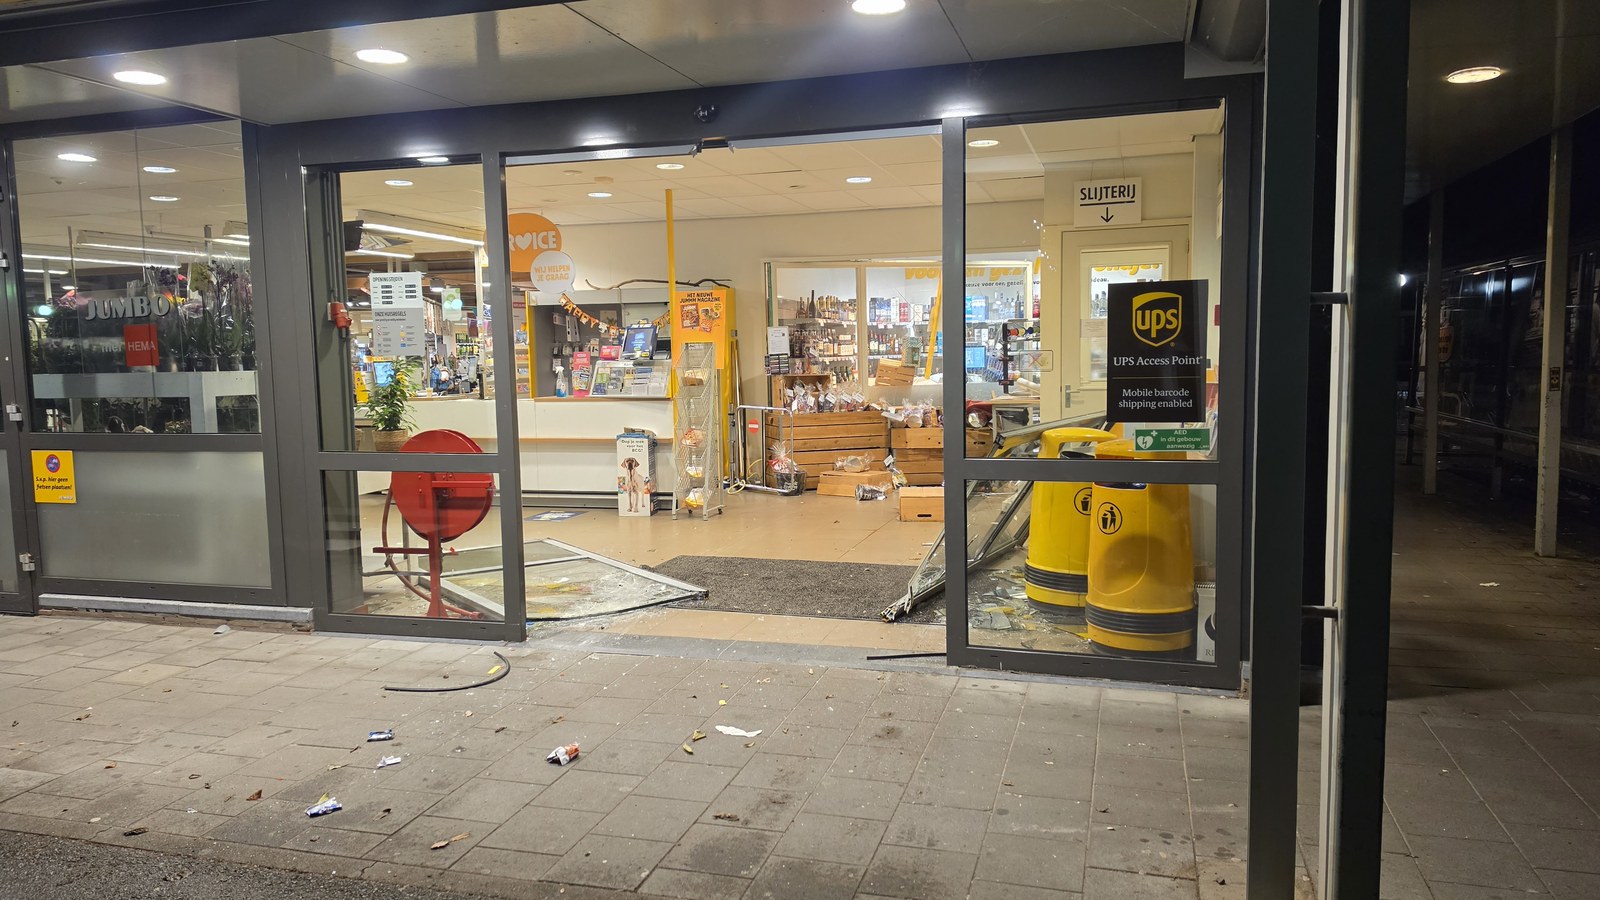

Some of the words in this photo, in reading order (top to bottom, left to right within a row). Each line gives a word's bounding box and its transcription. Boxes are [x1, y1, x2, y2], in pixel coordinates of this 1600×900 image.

[1080, 184, 1135, 201] SLIJTERIJ
[534, 265, 547, 274] WIJ
[547, 264, 571, 273] HELPEN
[536, 274, 544, 282] JE
[545, 273, 570, 281] GRAAG
[85, 294, 170, 320] JUMBO
[1136, 308, 1178, 338] ups
[127, 341, 156, 352] HEMA
[1113, 356, 1135, 366] UPS
[1136, 356, 1170, 366] Access
[1171, 355, 1200, 365] Point
[1122, 388, 1153, 397] Mobile
[1154, 388, 1190, 397] barcode
[1118, 399, 1157, 410] shipping
[1157, 399, 1193, 408] enabled
